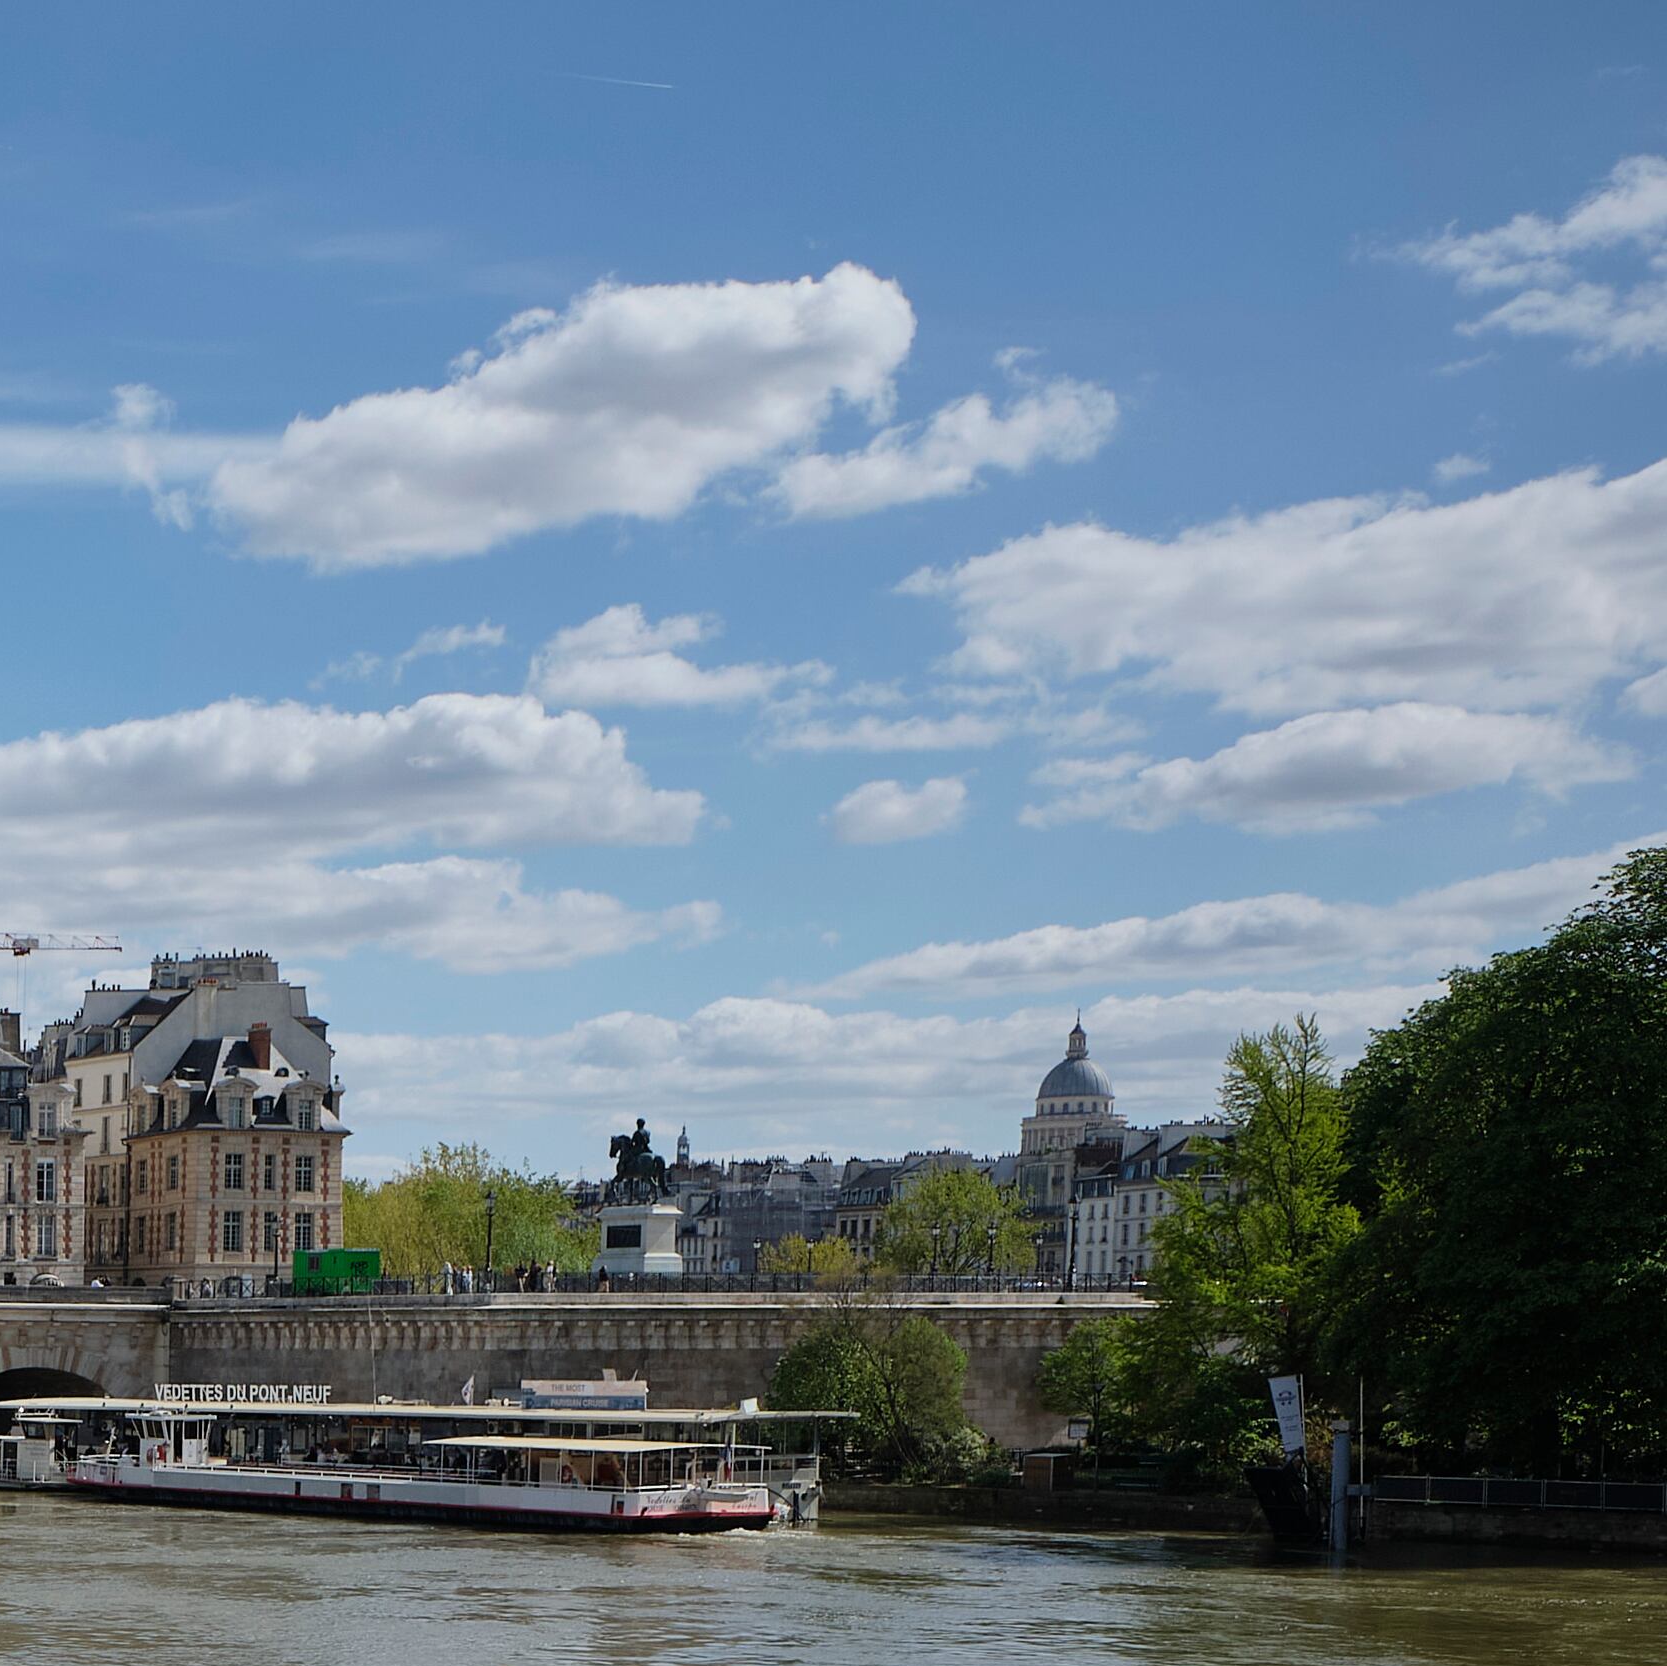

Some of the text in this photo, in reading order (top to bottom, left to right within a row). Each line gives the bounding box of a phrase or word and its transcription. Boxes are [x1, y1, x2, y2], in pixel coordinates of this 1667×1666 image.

[154, 1383, 332, 1404] VEDETTES DU PONT NEUF
[551, 1384, 586, 1392] THE MOST
